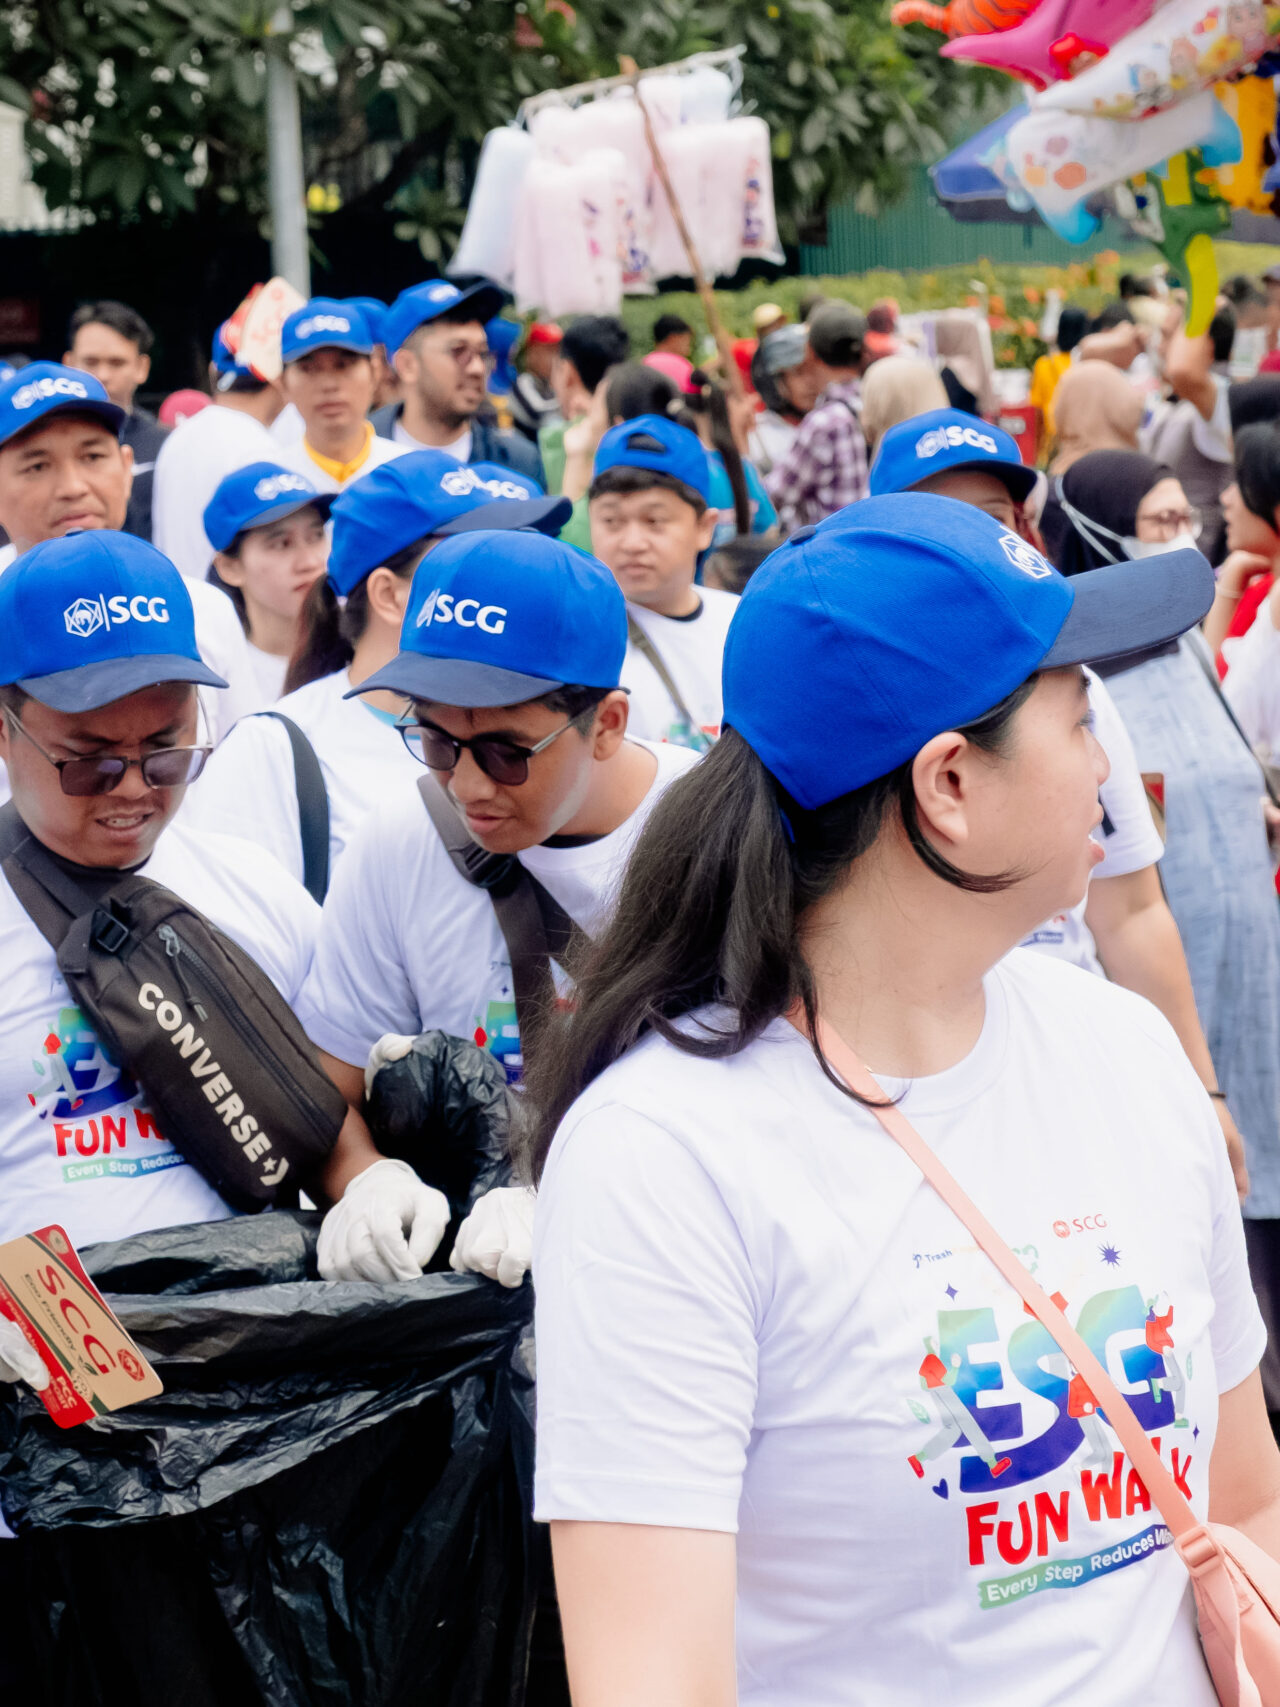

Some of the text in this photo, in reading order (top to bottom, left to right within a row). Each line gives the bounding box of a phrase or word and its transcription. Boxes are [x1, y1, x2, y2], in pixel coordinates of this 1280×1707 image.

[39, 377, 89, 399] SCG
[945, 425, 999, 454] SCG
[107, 595, 170, 624] SCG
[434, 594, 508, 634] SCG
[137, 982, 273, 1164] CONVERSE
[53, 1115, 127, 1157] FUN
[66, 1164, 104, 1180] Every
[109, 1161, 138, 1175] Step
[1072, 1213, 1108, 1233] SCG
[924, 1249, 953, 1263] Trash
[23, 1273, 77, 1351] Eco Friendly
[36, 1264, 117, 1375] SCG
[56, 1375, 78, 1409] PCC
[965, 1490, 1070, 1566] FUN
[986, 1573, 1038, 1602] Every
[1044, 1564, 1084, 1583] Step
[1089, 1533, 1155, 1572] Reduces
